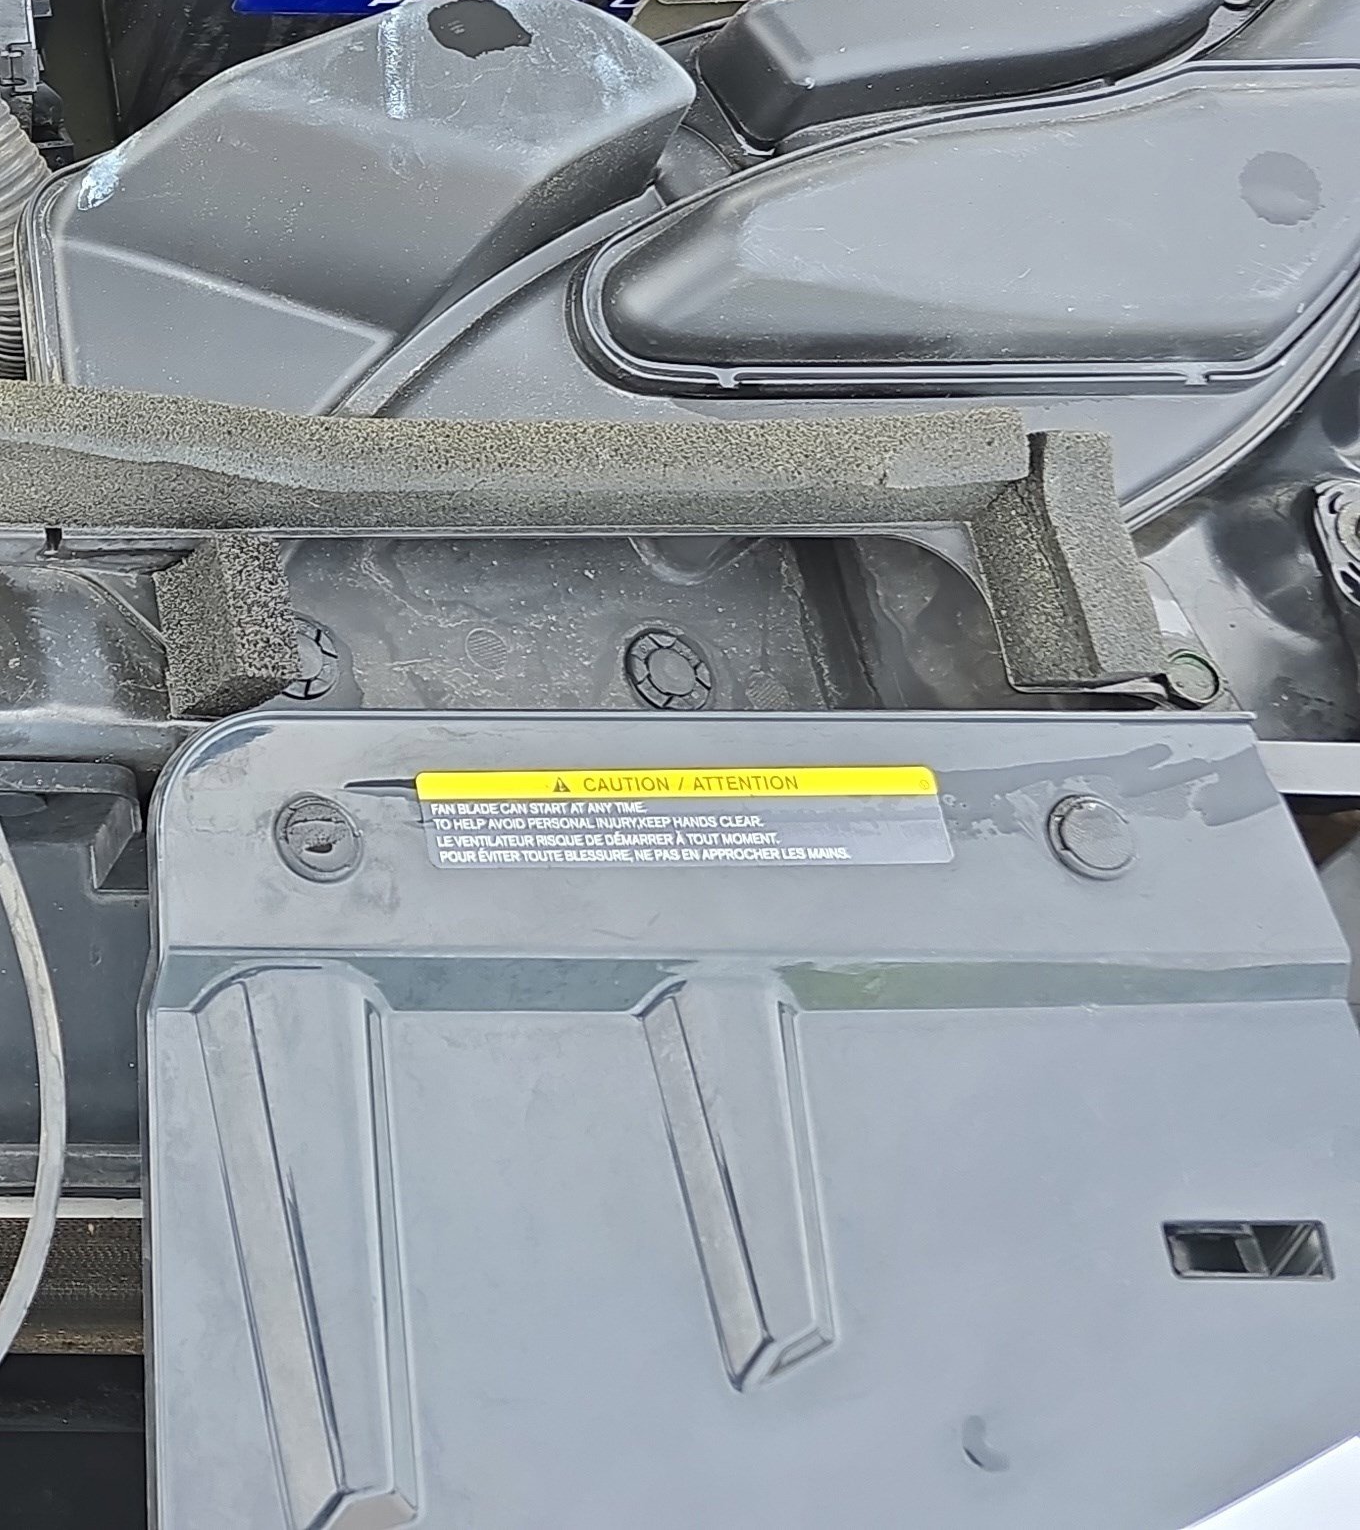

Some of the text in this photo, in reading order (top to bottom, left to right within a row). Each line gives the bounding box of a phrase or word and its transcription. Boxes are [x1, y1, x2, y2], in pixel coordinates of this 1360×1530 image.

[583, 776, 670, 793] CAUTION
[693, 774, 800, 791] ATTENTION
[430, 800, 648, 816] FAN BLADE CAN START AT ANY TIME.
[432, 818, 452, 831] TO
[453, 817, 487, 831] HELP
[488, 817, 527, 830] AVOID
[528, 817, 596, 830] PERSONAL
[673, 815, 718, 828] HANDS
[719, 815, 765, 828] CLEAR.
[436, 830, 781, 848] LE VENTILATEUR RISQUE DE DÉMARRER À TOUT MOMENT.
[439, 846, 851, 863] POUR ÉVITER TOUTE BLESSURE, NE PAS EN APPROCHER LES MAINS.
